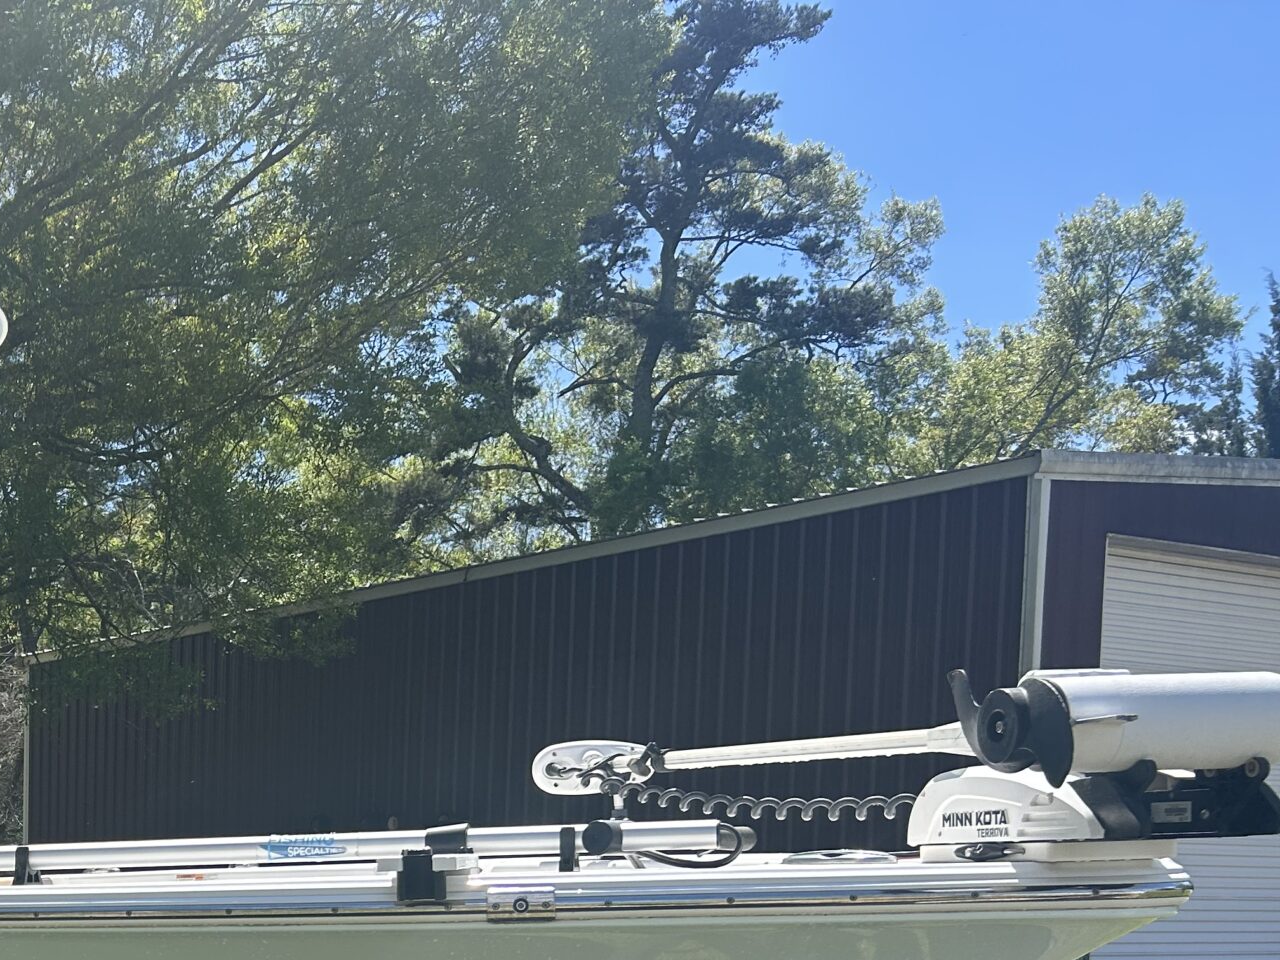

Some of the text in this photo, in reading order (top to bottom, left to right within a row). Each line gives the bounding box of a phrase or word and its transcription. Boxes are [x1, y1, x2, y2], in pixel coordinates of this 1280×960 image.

[942, 809, 1007, 827] MINN KOTA
[976, 827, 1009, 838] TERROVA
